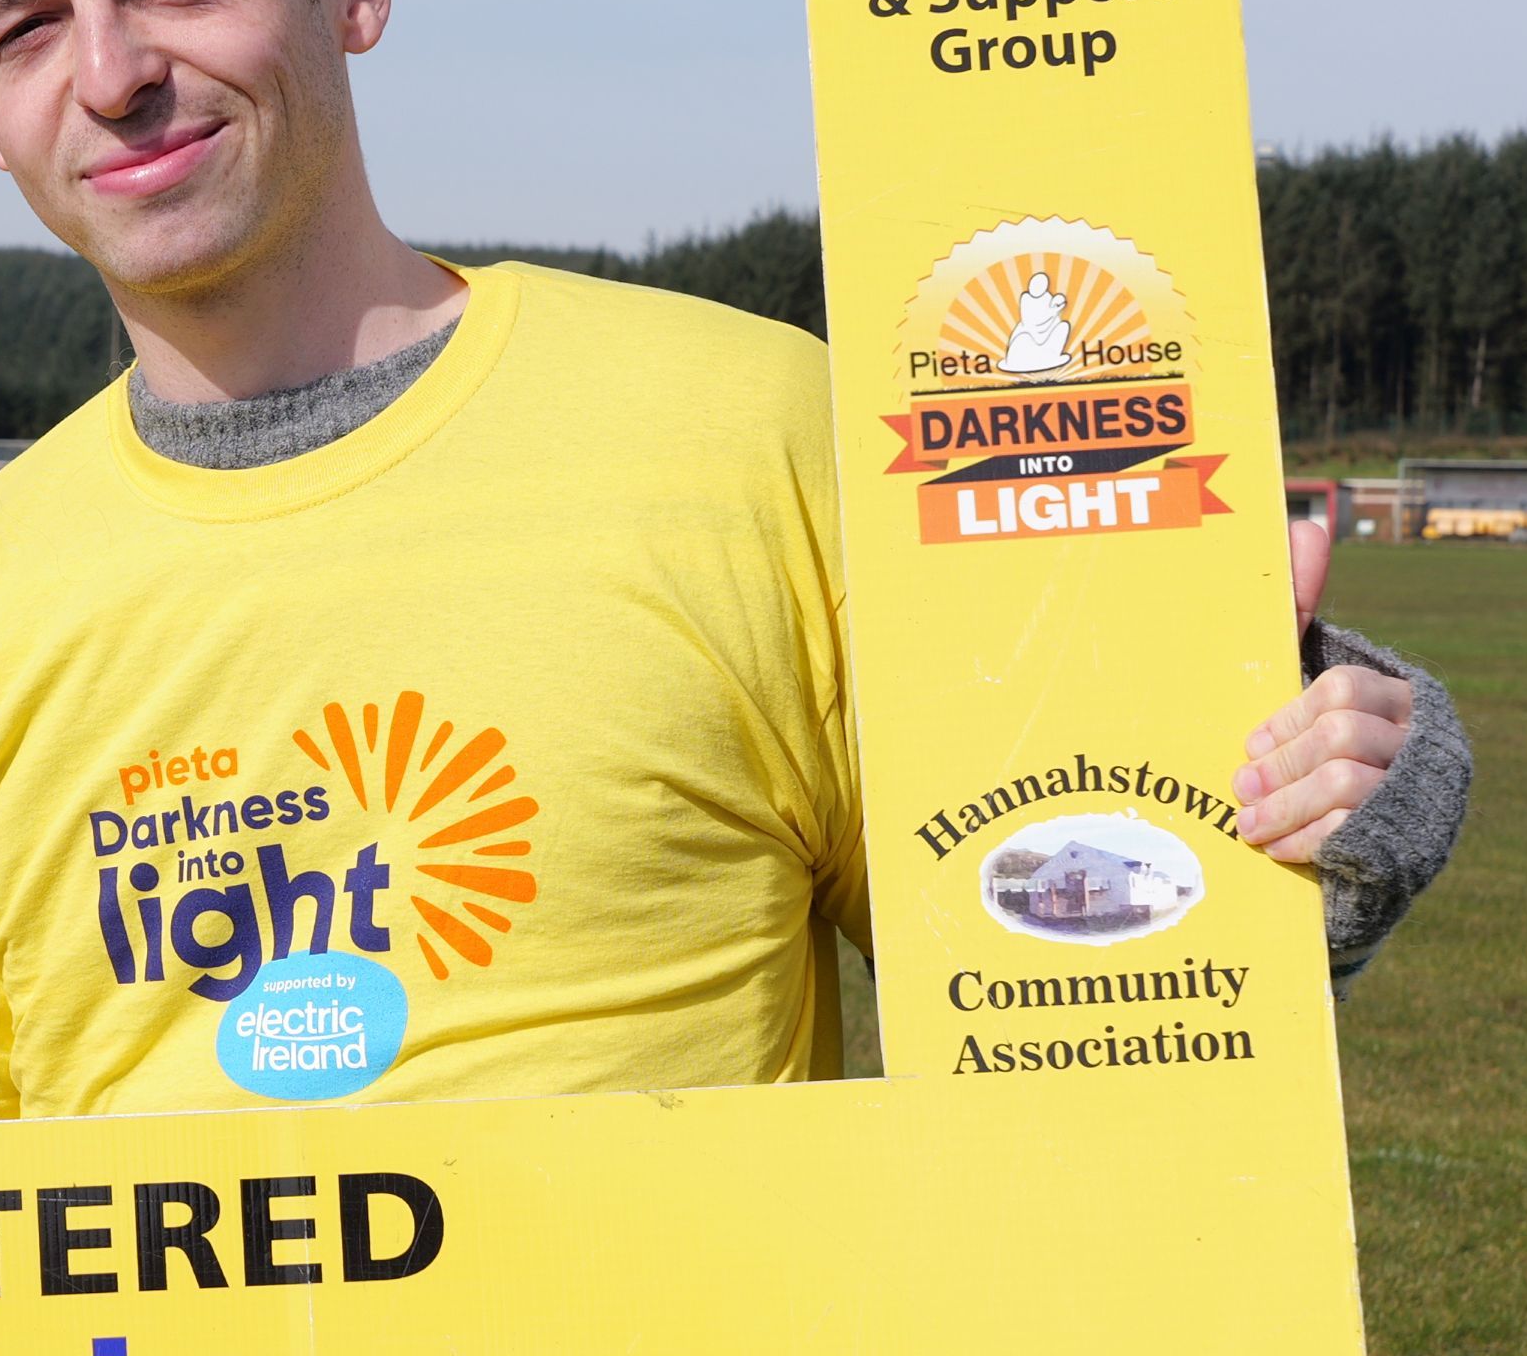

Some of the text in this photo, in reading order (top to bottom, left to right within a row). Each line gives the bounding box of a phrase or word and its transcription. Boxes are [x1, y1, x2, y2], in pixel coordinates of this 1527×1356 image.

[931, 28, 1116, 76] Group
[910, 340, 1182, 378] Pieta House
[920, 394, 1186, 451] DARKNESS
[1019, 455, 1073, 475] INTO
[957, 477, 1160, 535] LIGHT
[119, 746, 238, 805] pieta
[89, 786, 330, 857] Darkness
[178, 850, 244, 883] into
[98, 842, 390, 1002] light
[263, 974, 355, 993] supported by
[948, 958, 1249, 1012] Community
[236, 1000, 363, 1037] electric
[252, 1032, 367, 1071] Ireland
[952, 1022, 1255, 1074] Association
